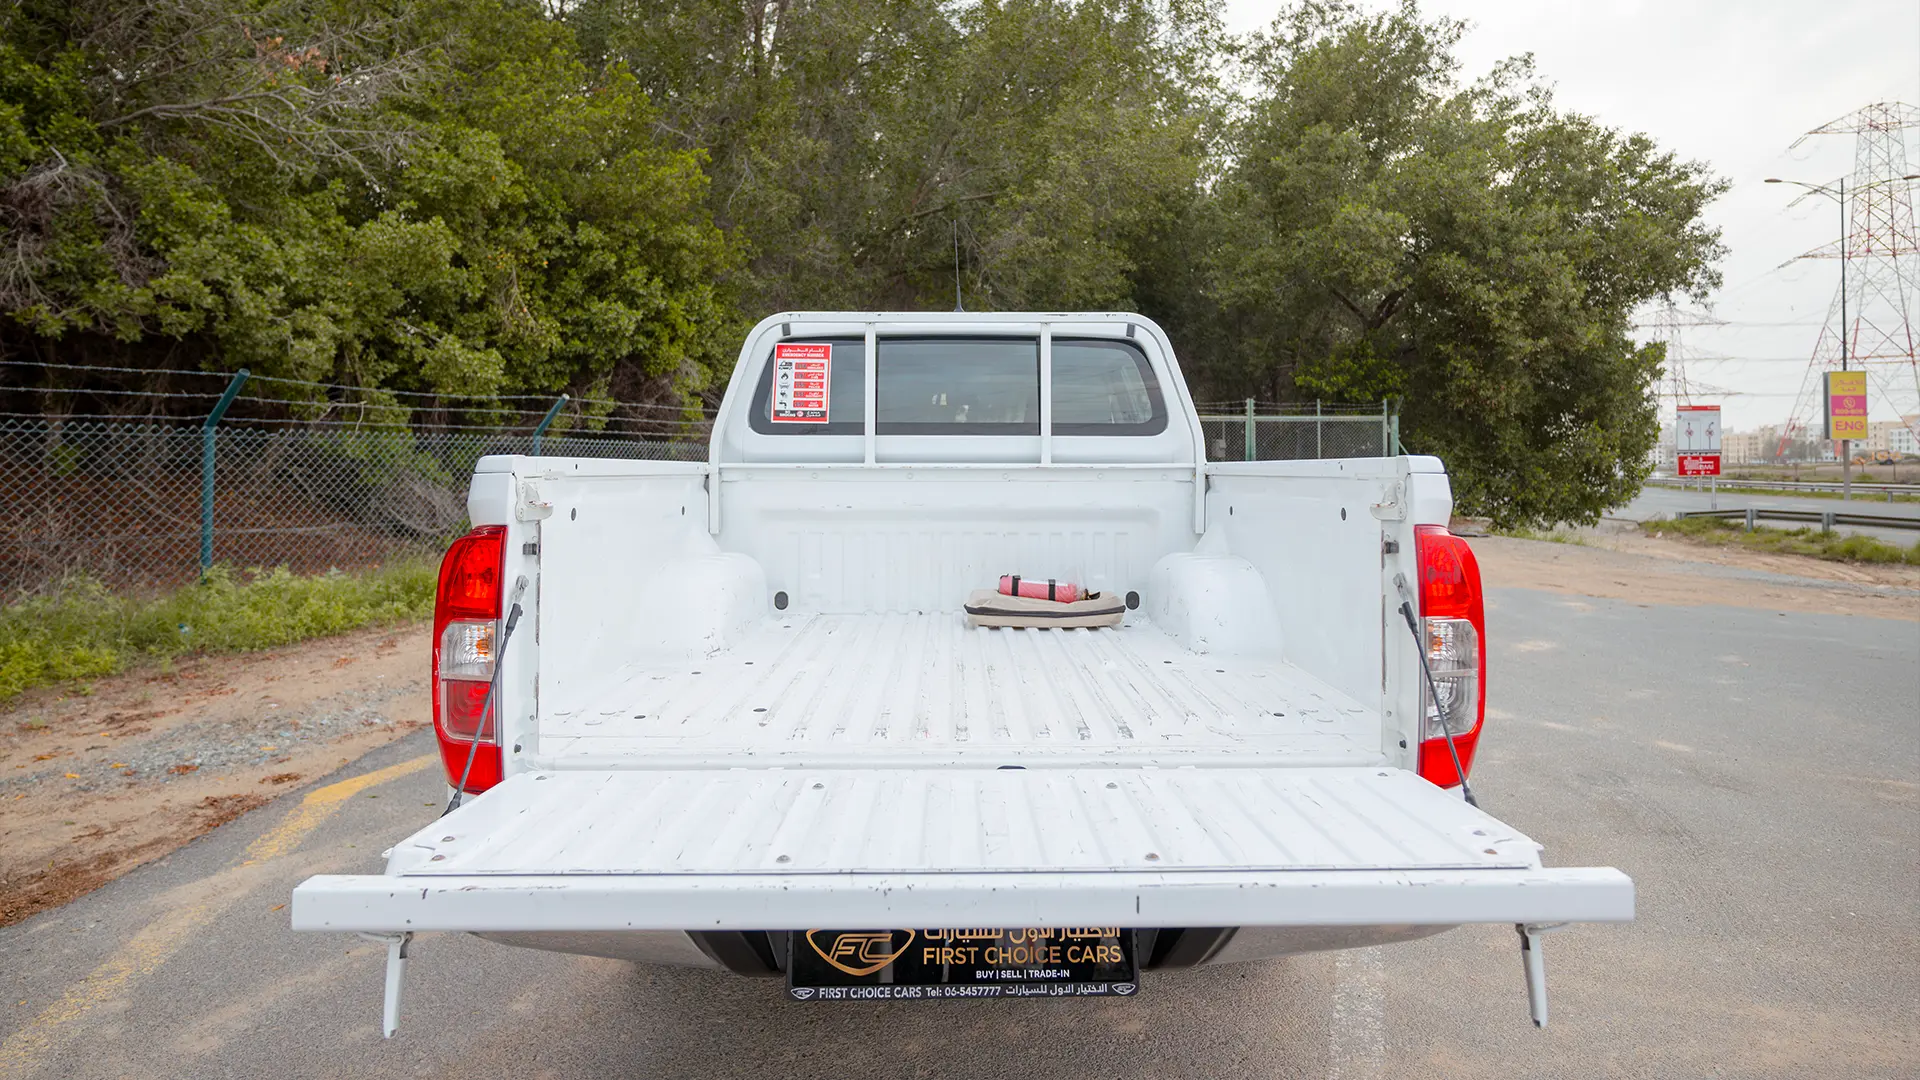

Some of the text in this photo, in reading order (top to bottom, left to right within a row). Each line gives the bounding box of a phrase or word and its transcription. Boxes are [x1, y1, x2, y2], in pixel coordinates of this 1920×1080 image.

[1835, 420, 1864, 431] ENG
[923, 945, 1122, 965] FIRST CHOICE CARS
[976, 970, 994, 979] BUY
[1001, 970, 1022, 979] SELL
[1028, 969, 1070, 978] TRADE-IN
[819, 987, 848, 999] FIRST
[850, 987, 891, 999] CHOICE
[893, 986, 922, 998] CARS
[925, 986, 942, 997] Tel:
[944, 985, 1001, 997] 06-5457777
